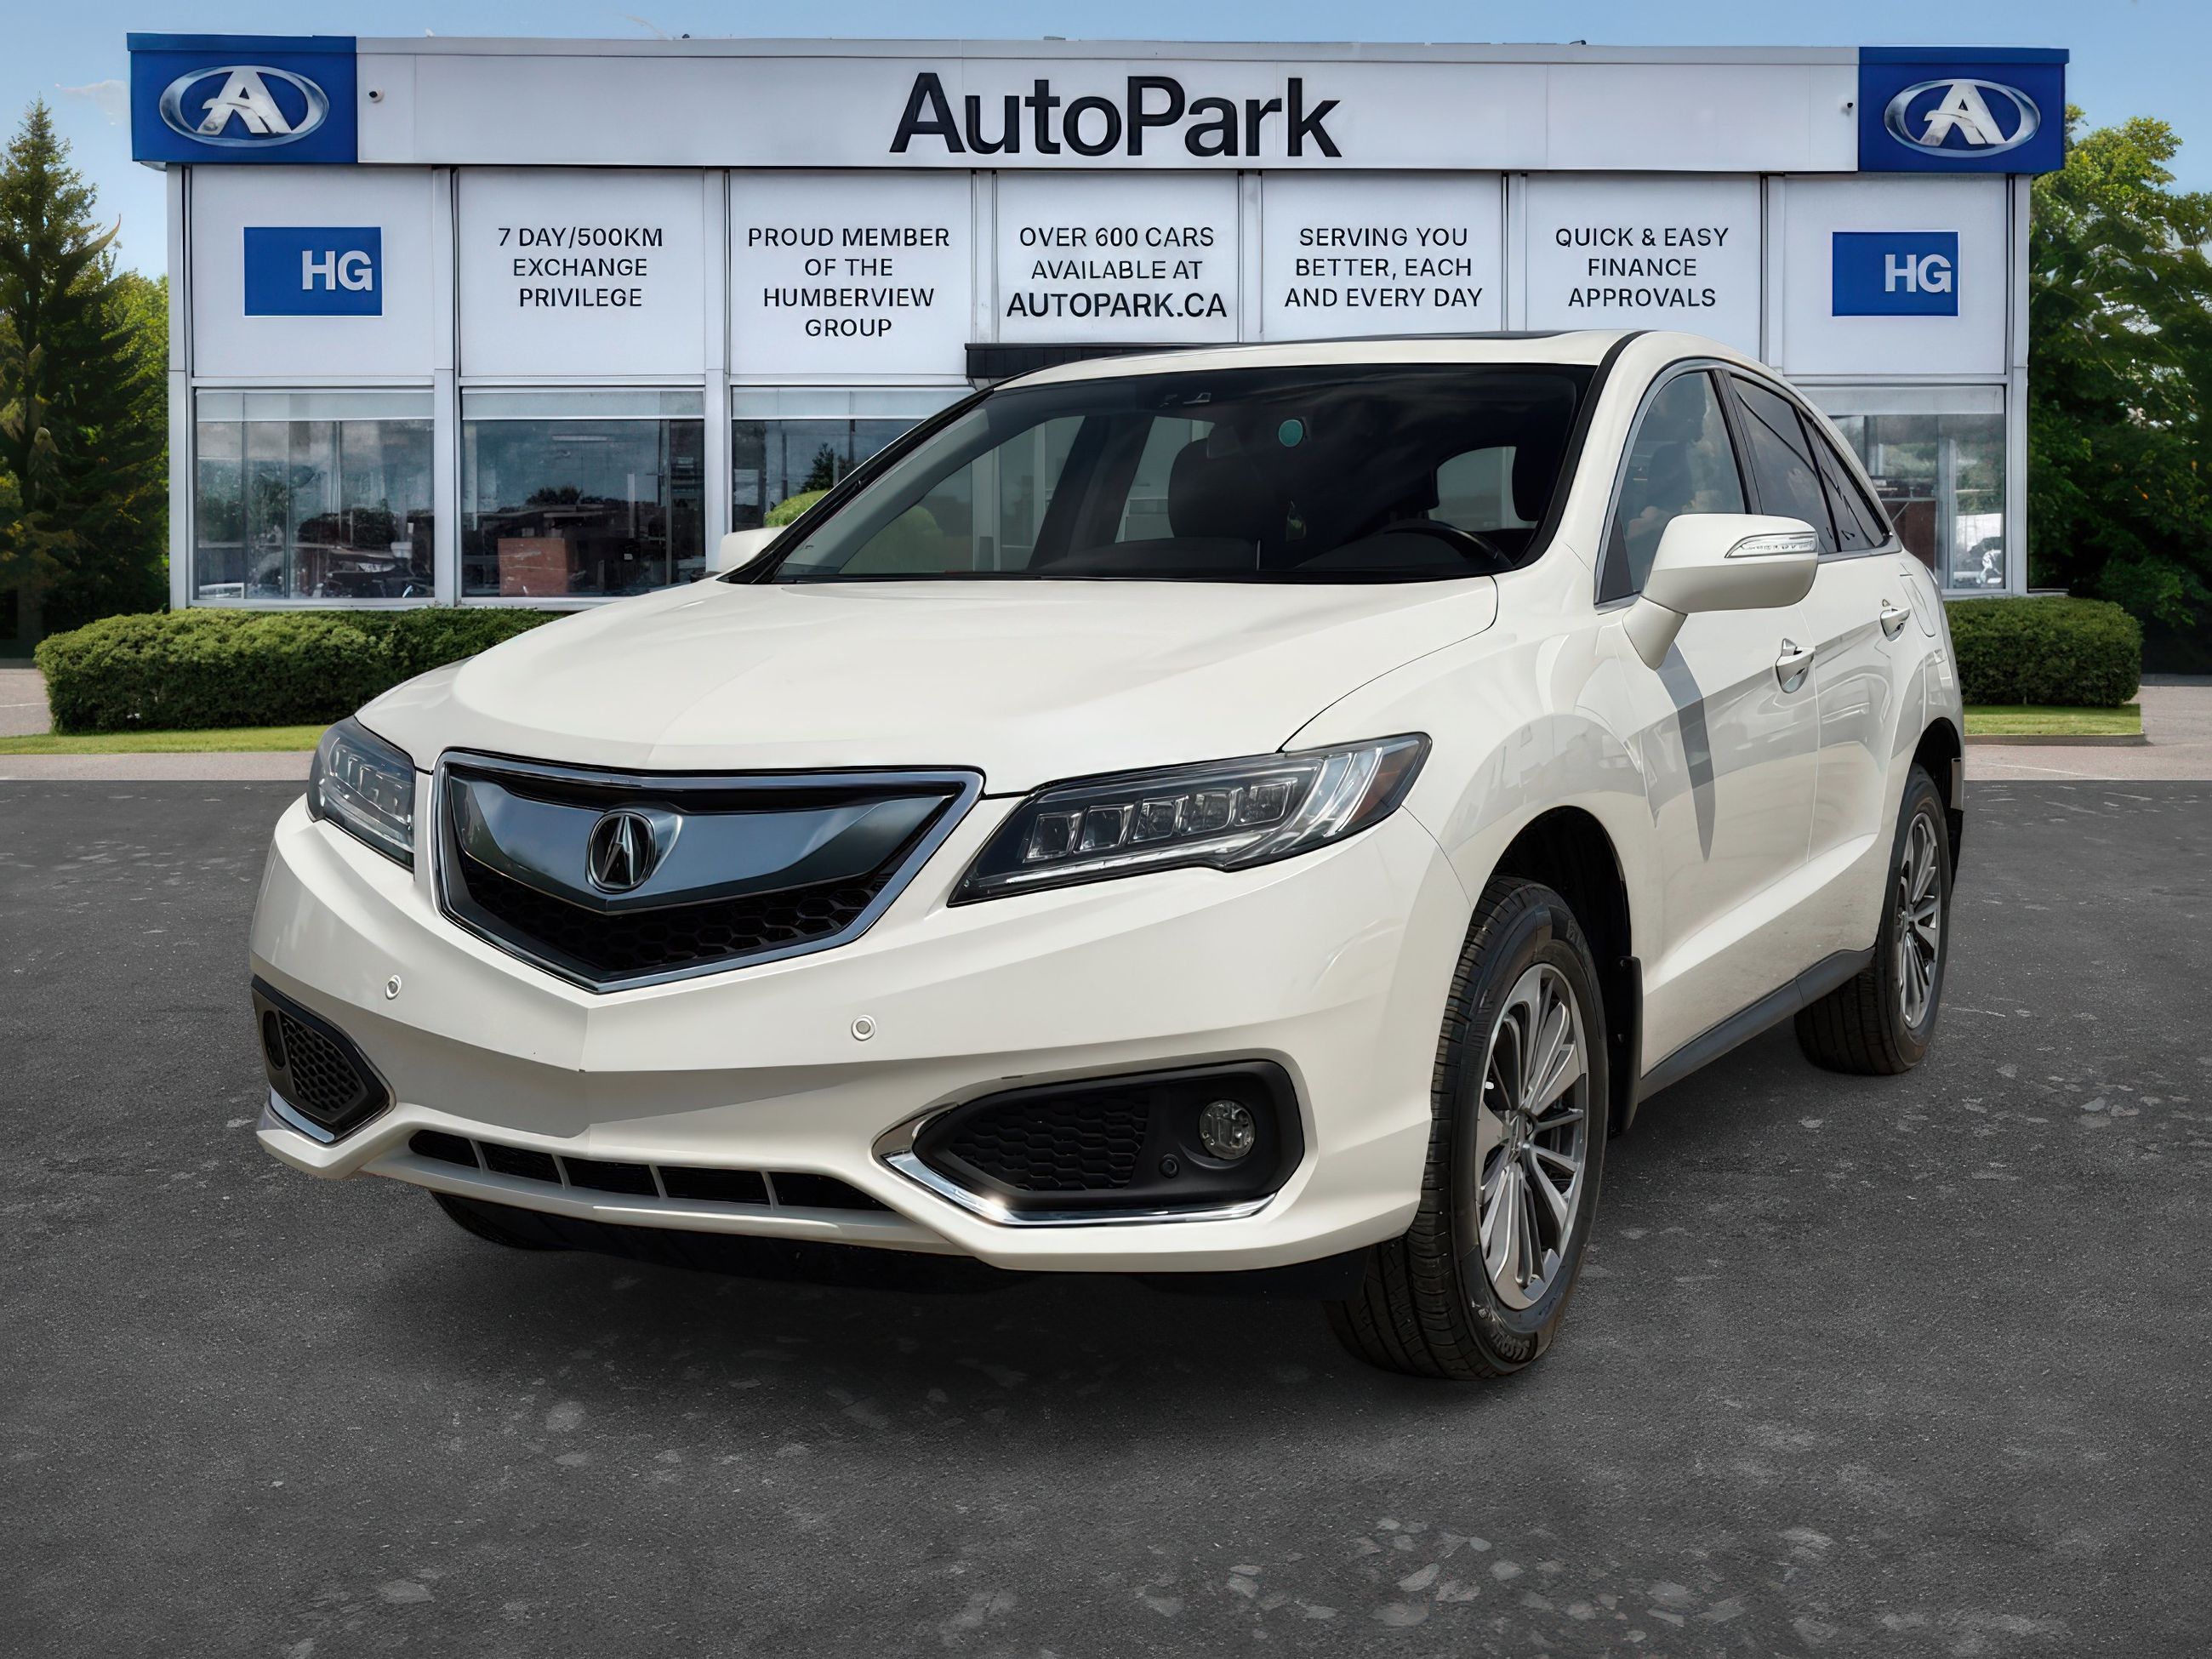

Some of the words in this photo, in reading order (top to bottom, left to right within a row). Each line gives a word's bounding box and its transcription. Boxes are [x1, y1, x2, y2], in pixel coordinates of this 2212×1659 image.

[889, 72, 1343, 158] AutoPark
[498, 227, 511, 247] 7
[519, 226, 663, 249] DAY/500KM
[748, 227, 834, 248] PROUD
[842, 227, 949, 247] MEMBER
[1019, 226, 1087, 248] OVER
[1095, 226, 1138, 248] 600
[1145, 226, 1214, 248] CARS
[1299, 227, 1408, 247] SERVING
[1416, 227, 1468, 247] YOU
[1555, 227, 1633, 248] QUICK
[1641, 227, 1656, 247] &
[1664, 227, 1729, 247] EASY
[302, 250, 373, 291] HG
[513, 258, 647, 277] EXCHANGE
[804, 258, 836, 276] OF
[844, 258, 893, 276] THE
[1031, 259, 1166, 280] AVAILABLE
[1172, 259, 1203, 280] AT
[1296, 258, 1397, 281] BETTER,
[1405, 258, 1472, 277] EACH
[1588, 258, 1696, 277] FINANCE
[1884, 254, 1952, 294] HG
[519, 288, 642, 307] PRIVILEGE
[764, 288, 935, 307] HUMBERVIEW
[1006, 292, 1228, 318] AUTOPARK.CA
[1284, 288, 1337, 308] AND
[1346, 288, 1426, 307] EVERY
[1434, 287, 1483, 307] DAY
[1567, 288, 1716, 308] APPROVALS
[805, 318, 892, 338] GROUP
